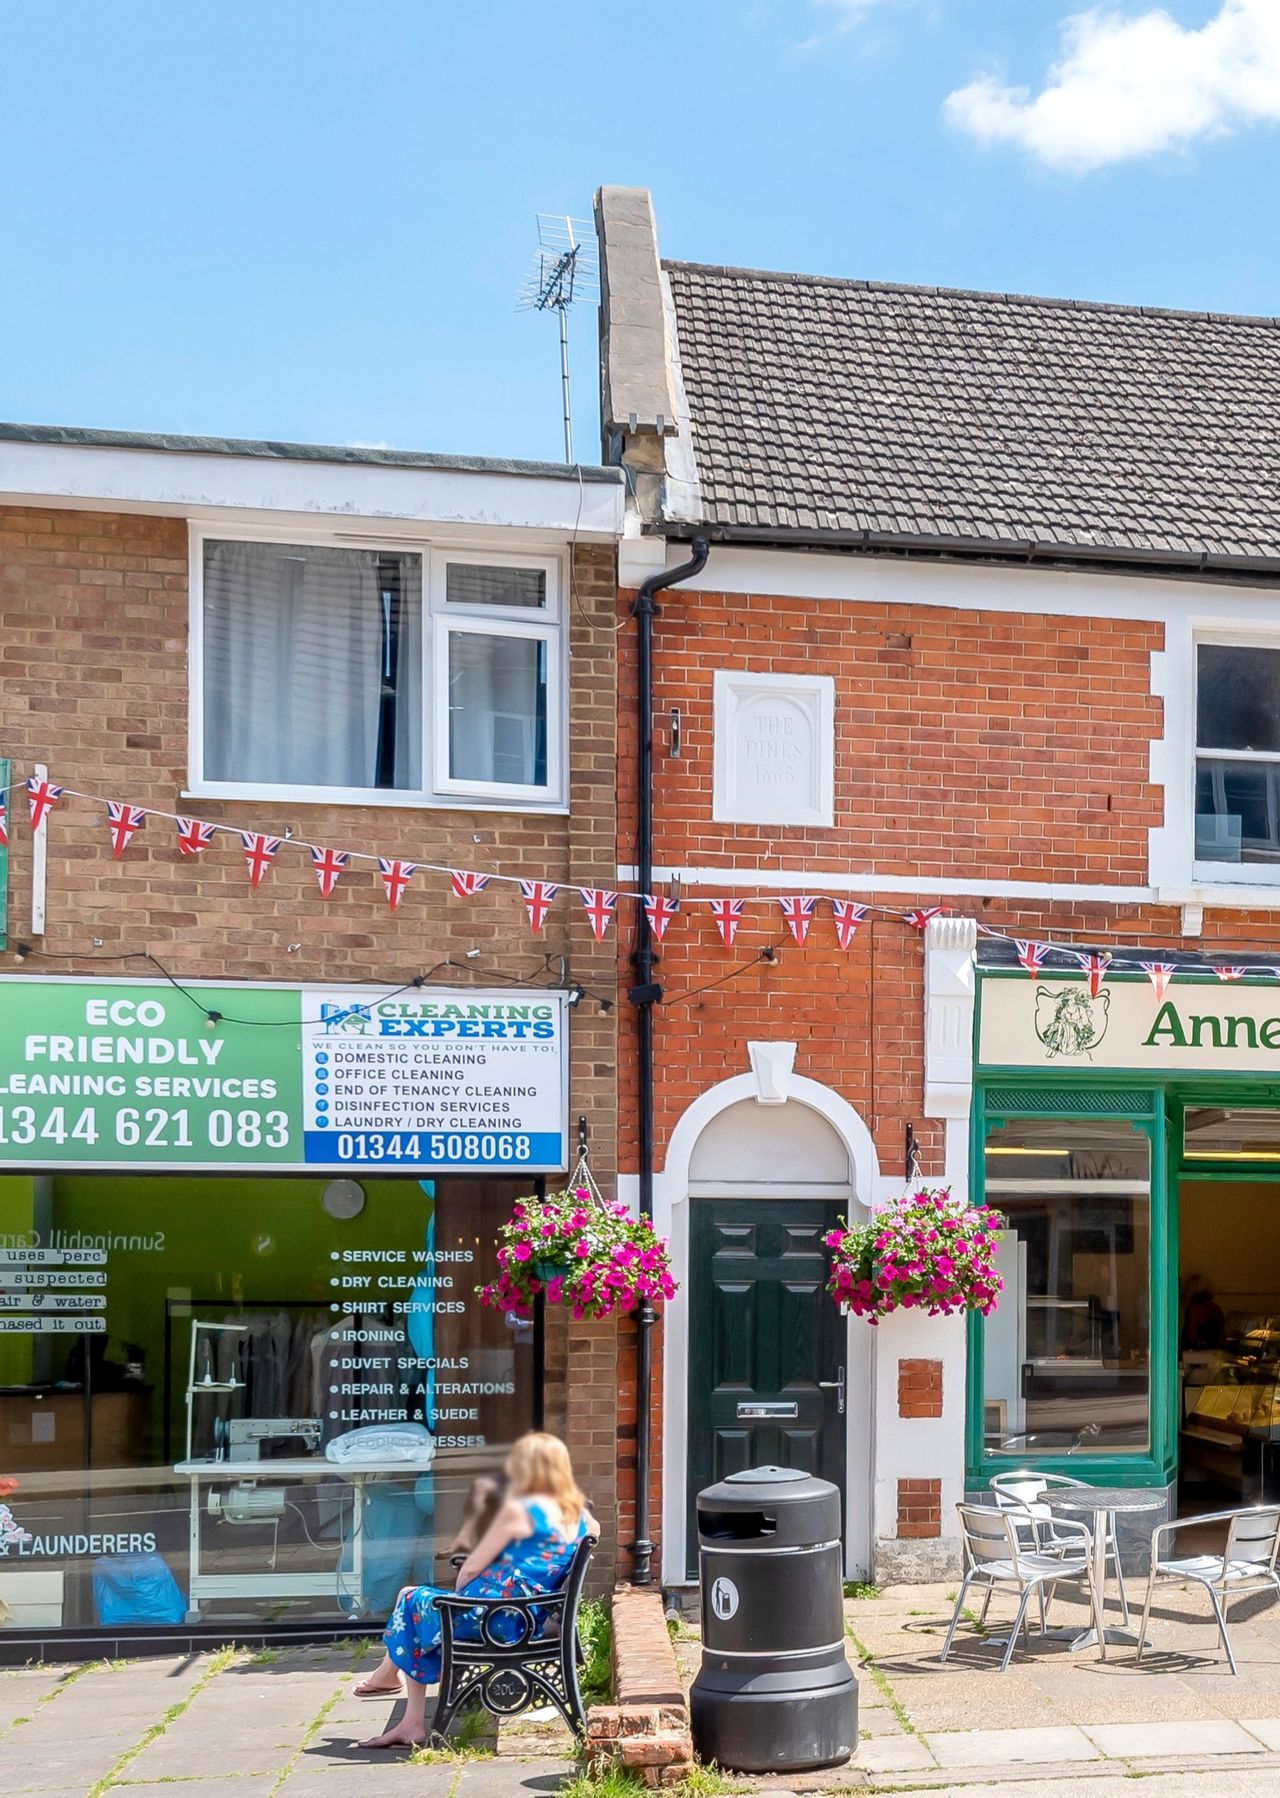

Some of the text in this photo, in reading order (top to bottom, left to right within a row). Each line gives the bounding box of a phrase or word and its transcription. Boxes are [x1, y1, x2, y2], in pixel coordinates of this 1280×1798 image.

[754, 716, 793, 736] THE
[746, 740, 803, 759] PINES
[86, 999, 166, 1027] ECO
[377, 1003, 553, 1020] CLEANING
[378, 1019, 555, 1039] EXPERTS
[25, 1035, 224, 1065] FRIENDLY
[312, 1042, 333, 1050] WE
[339, 1042, 384, 1051] CLEAN
[389, 1042, 406, 1051] SO
[413, 1043, 440, 1051] YOU
[445, 1044, 486, 1052] DON'T
[334, 1053, 487, 1065] DOMESTIC CLEANING
[334, 1068, 465, 1081] OFFICE CLEANING
[135, 1076, 278, 1099] SERVICES
[334, 1085, 537, 1098] END OF TENANCY CLEANING
[334, 1101, 510, 1112] DISINFECTION SERVICES
[115, 1107, 193, 1147] 621
[208, 1108, 290, 1148] 083
[334, 1117, 403, 1128] LAUNDRY
[416, 1117, 445, 1128] DRY
[449, 1118, 522, 1129] CLEANING
[337, 1133, 531, 1161] 01344 508068
[7, 1249, 106, 1264] uses "perc"
[343, 1251, 474, 1262] SERVICE WASHES
[15, 1272, 106, 1287] suspected
[342, 1276, 454, 1288] DRY CLEANING
[32, 1294, 45, 1307] &
[55, 1297, 106, 1308] water.
[342, 1302, 466, 1313] SHIRT SERVICES
[53, 1318, 65, 1330] it
[74, 1320, 106, 1330] out.
[343, 1331, 405, 1342] IRONING
[341, 1357, 469, 1369] DUVET SPECIALS
[341, 1383, 515, 1395] REPAIR & ALTERATIONS
[341, 1408, 478, 1420] LEATHER & SUEDE
[427, 1435, 487, 1448] RESSES
[19, 1532, 157, 1556] LAUNDERERS
